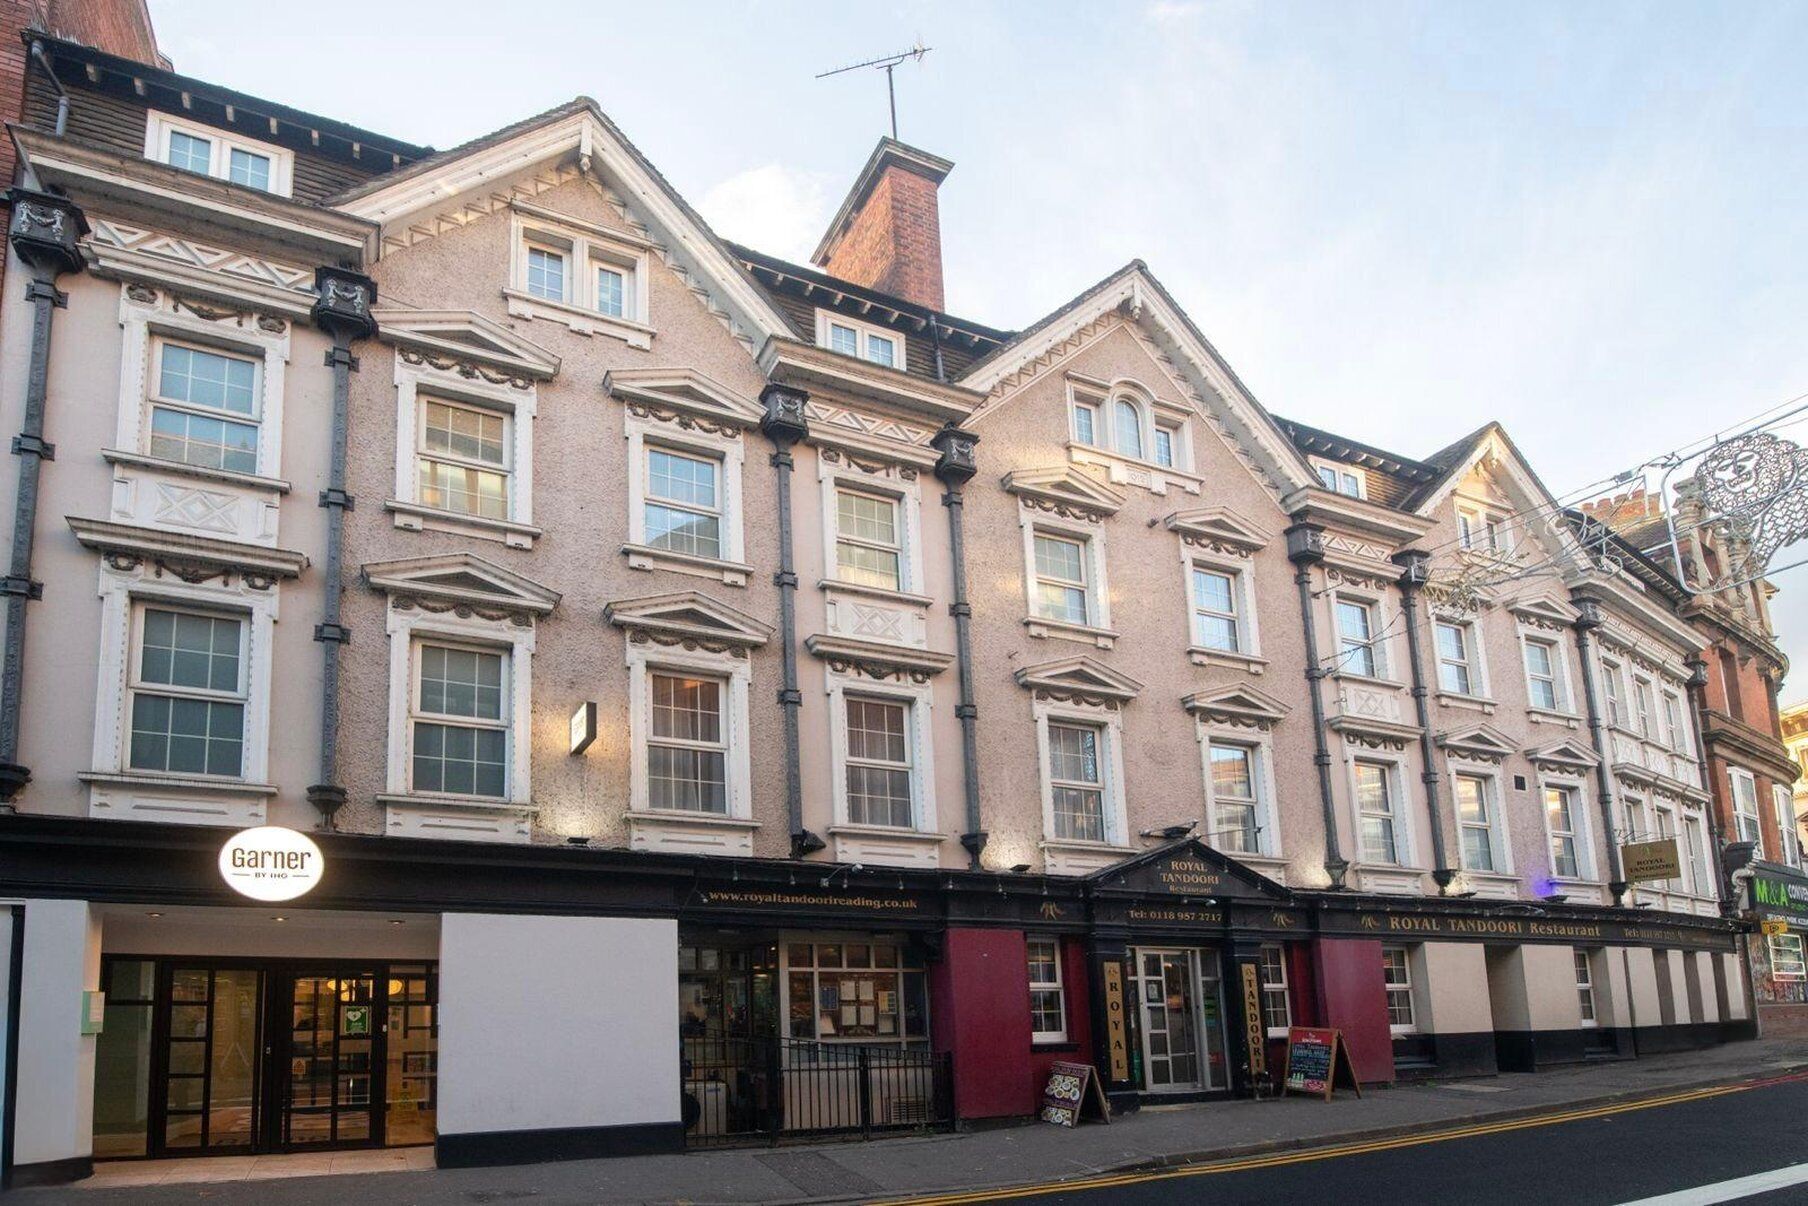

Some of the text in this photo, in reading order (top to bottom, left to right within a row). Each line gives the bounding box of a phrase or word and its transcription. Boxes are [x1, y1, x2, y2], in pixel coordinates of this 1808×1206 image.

[231, 847, 311, 870] Garner
[1171, 861, 1208, 872] ROYAL
[1162, 873, 1220, 885] TANDOORI
[1129, 910, 1147, 919] Tel:
[1150, 911, 1175, 920] 0118
[1389, 916, 1601, 937] ROYAL TANDOORI Restaurant
[1109, 981, 1124, 1070] ROYAL
[1248, 979, 1265, 1068] TANDOORI
